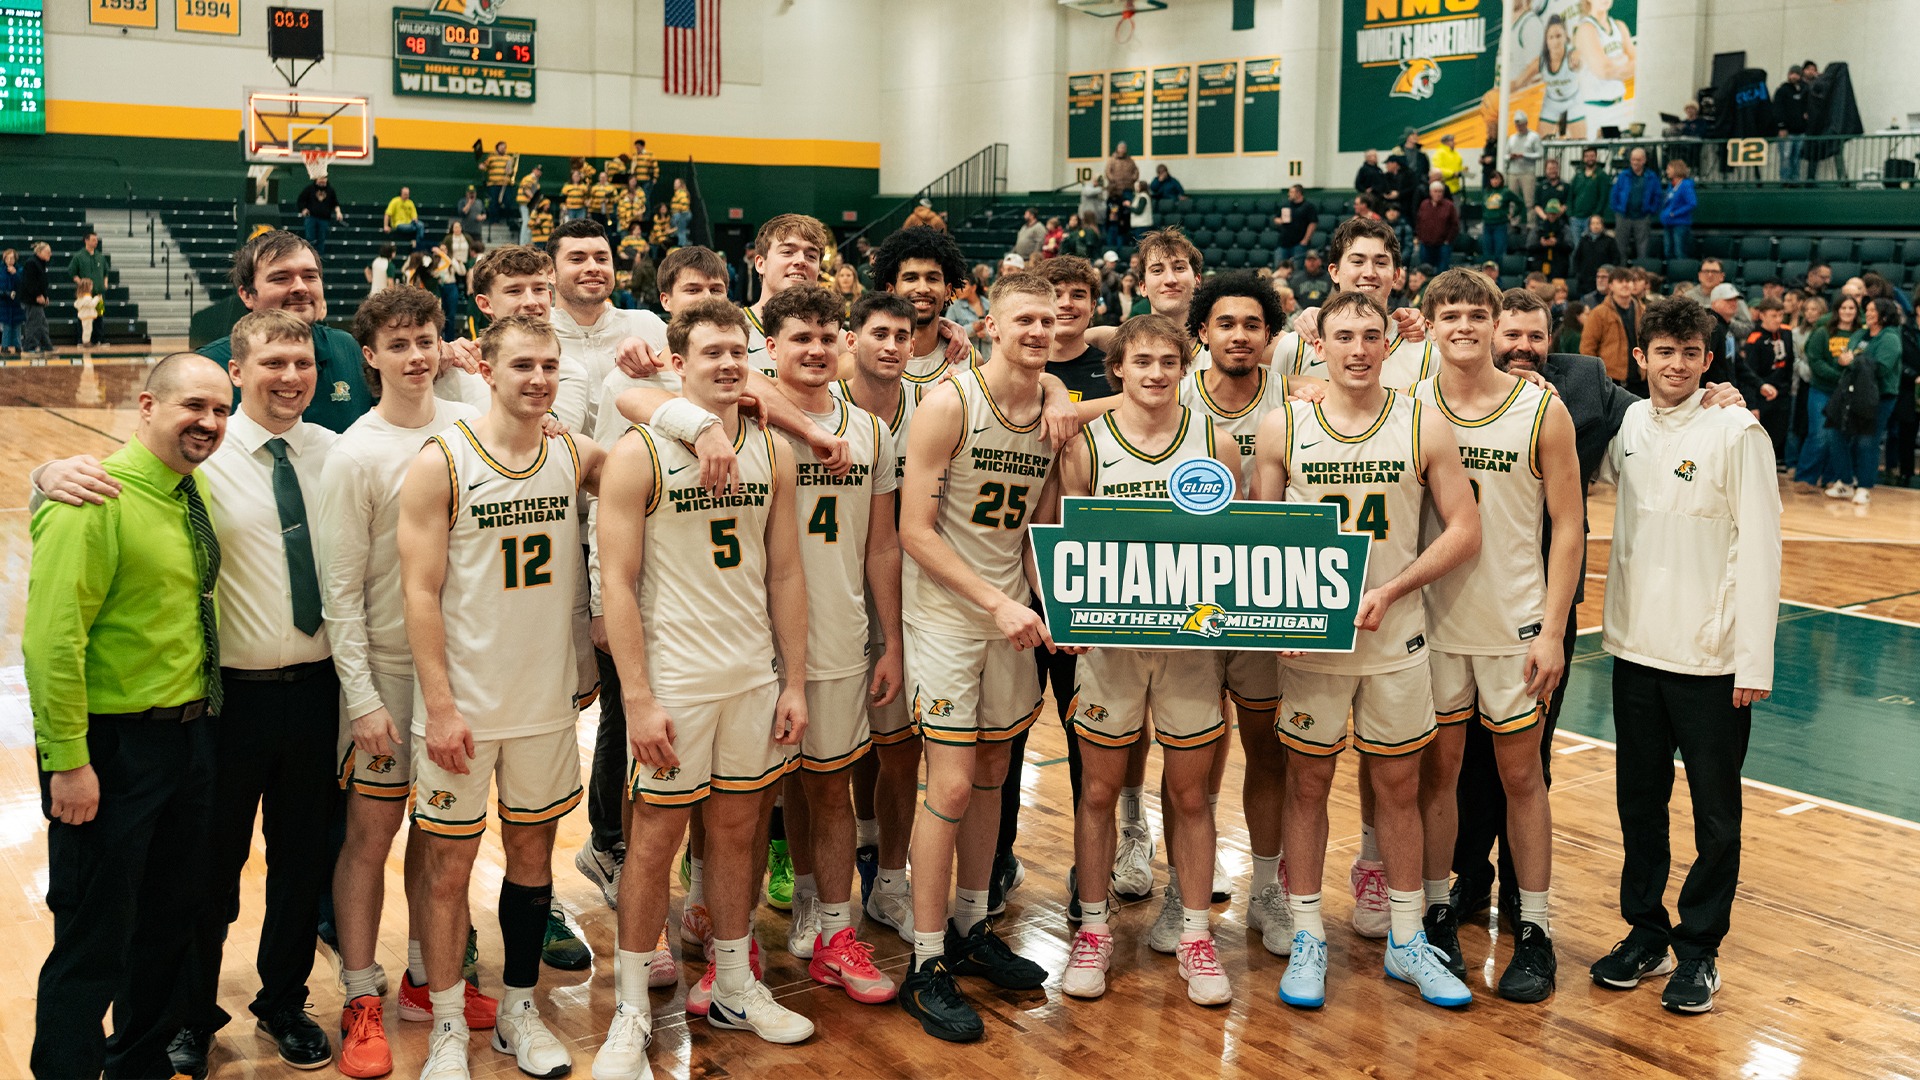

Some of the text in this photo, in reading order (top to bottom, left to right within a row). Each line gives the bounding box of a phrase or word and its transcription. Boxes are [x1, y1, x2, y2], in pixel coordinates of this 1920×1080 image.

[184, 0, 231, 18] 1994
[274, 11, 309, 28] 00.0
[399, 24, 440, 36] WILDCATS
[445, 26, 479, 45] 00.0
[506, 32, 531, 43] GUEST
[406, 37, 426, 54] 98
[1357, 17, 1486, 63] WOMEN'S BASKETBALL
[512, 45, 531, 62] 75
[425, 63, 506, 78] HOME OF THE
[400, 72, 532, 98] WILDCATS
[21, 101, 37, 112] 12
[1729, 140, 1766, 164] 12
[1076, 168, 1092, 182] 10
[1289, 161, 1302, 176] 11
[971, 447, 1051, 468] NORTHERN
[1458, 446, 1519, 463] THERN
[973, 459, 1046, 479] MICHIGAN
[1301, 460, 1405, 474] NORTHERN
[1460, 457, 1512, 474] HIGAN
[796, 475, 863, 487] ICHIGAN
[1307, 472, 1400, 485] MICHIGAN
[1674, 468, 1693, 482] NMU
[669, 483, 769, 501] NORHERN
[1102, 480, 1167, 496] NORTH
[1181, 483, 1223, 494] GLIAC
[470, 495, 569, 517] NORTHERN
[675, 494, 765, 513] MICHIGAN
[969, 480, 1031, 530] 25
[478, 508, 566, 529] MICHIGAN
[807, 494, 840, 544] 4
[709, 516, 743, 571] 5
[500, 532, 552, 591] 12
[1053, 540, 1351, 610] CHAMPIONS
[1074, 611, 1188, 627] NORTHERN
[1225, 617, 1325, 630] MICHIGAN
